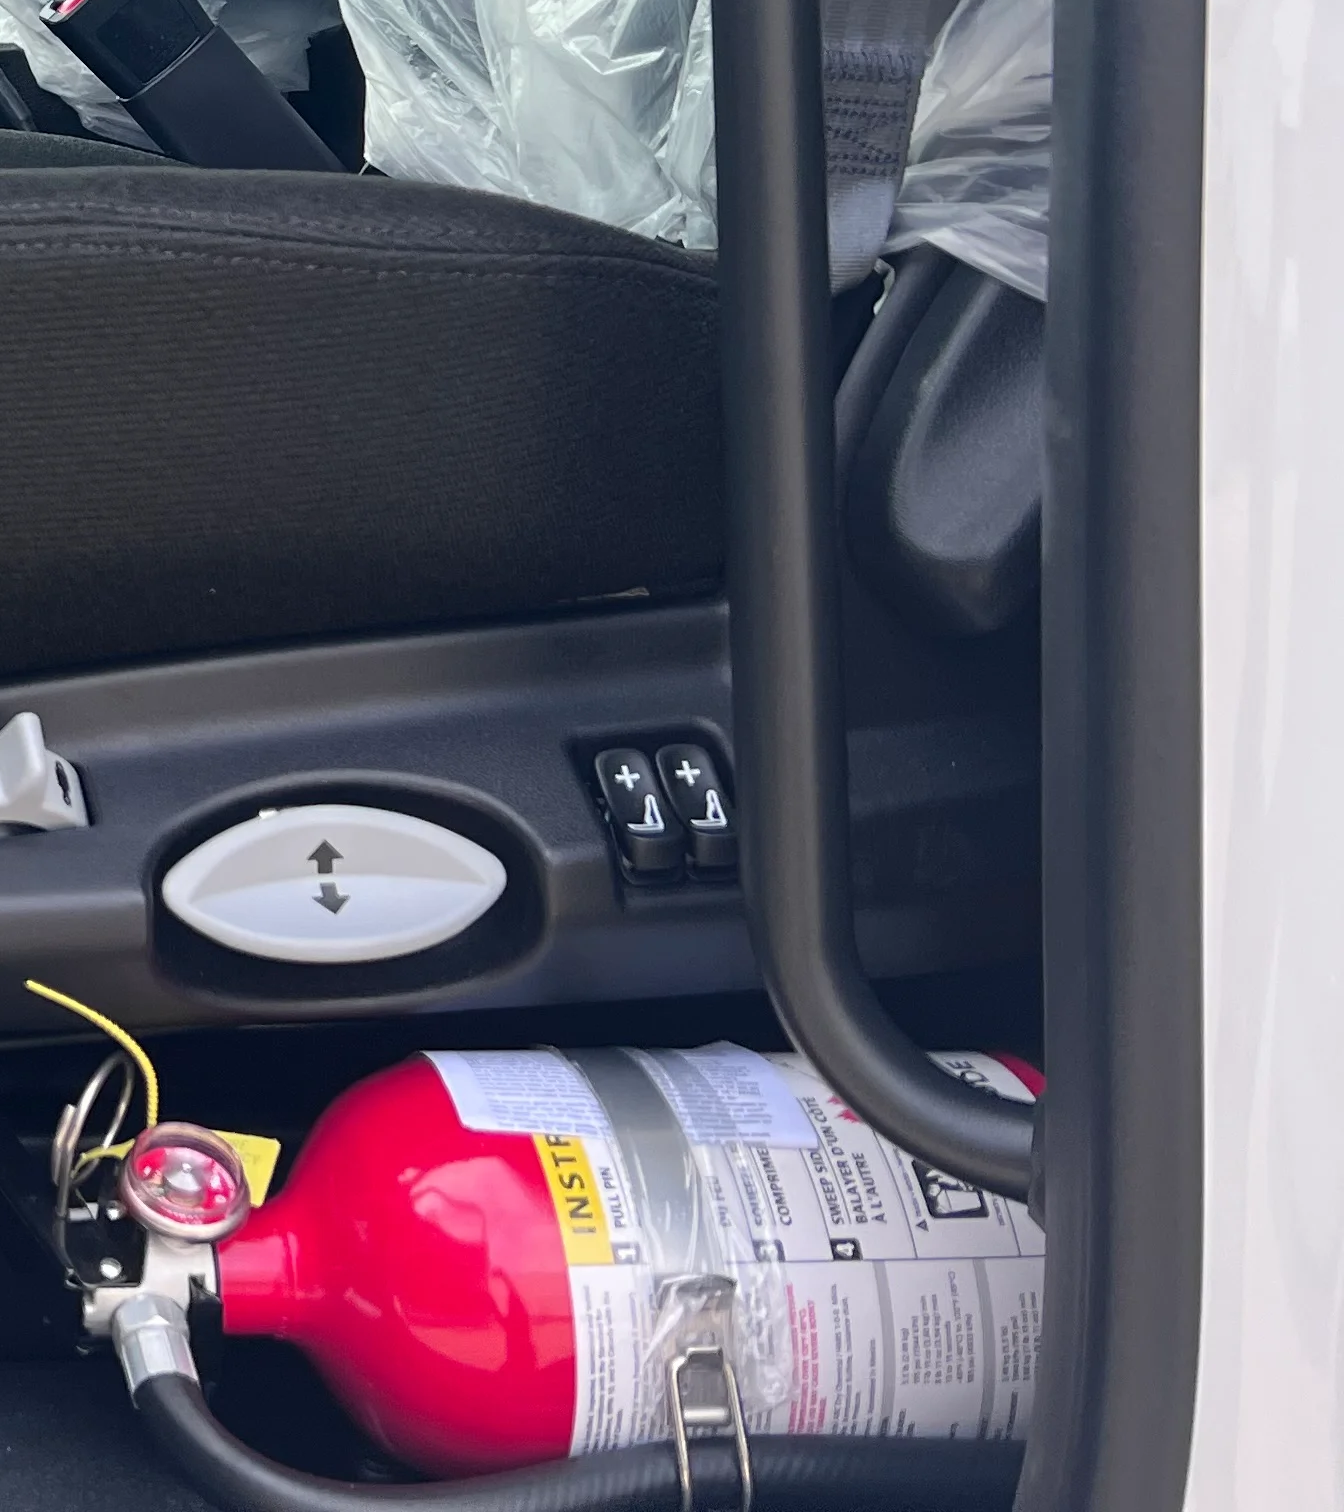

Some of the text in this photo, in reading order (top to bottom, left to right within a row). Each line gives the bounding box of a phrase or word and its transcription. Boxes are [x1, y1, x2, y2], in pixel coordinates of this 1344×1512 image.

[824, 1125, 845, 1156] D'UN
[598, 1167, 626, 1228] PULL PIN
[820, 1178, 845, 1225] SWEEP
[836, 1160, 869, 1224] BALAYER
[852, 1152, 882, 1209] L'AUTRE
[617, 1247, 636, 1259] 1
[836, 1243, 855, 1258] 4
